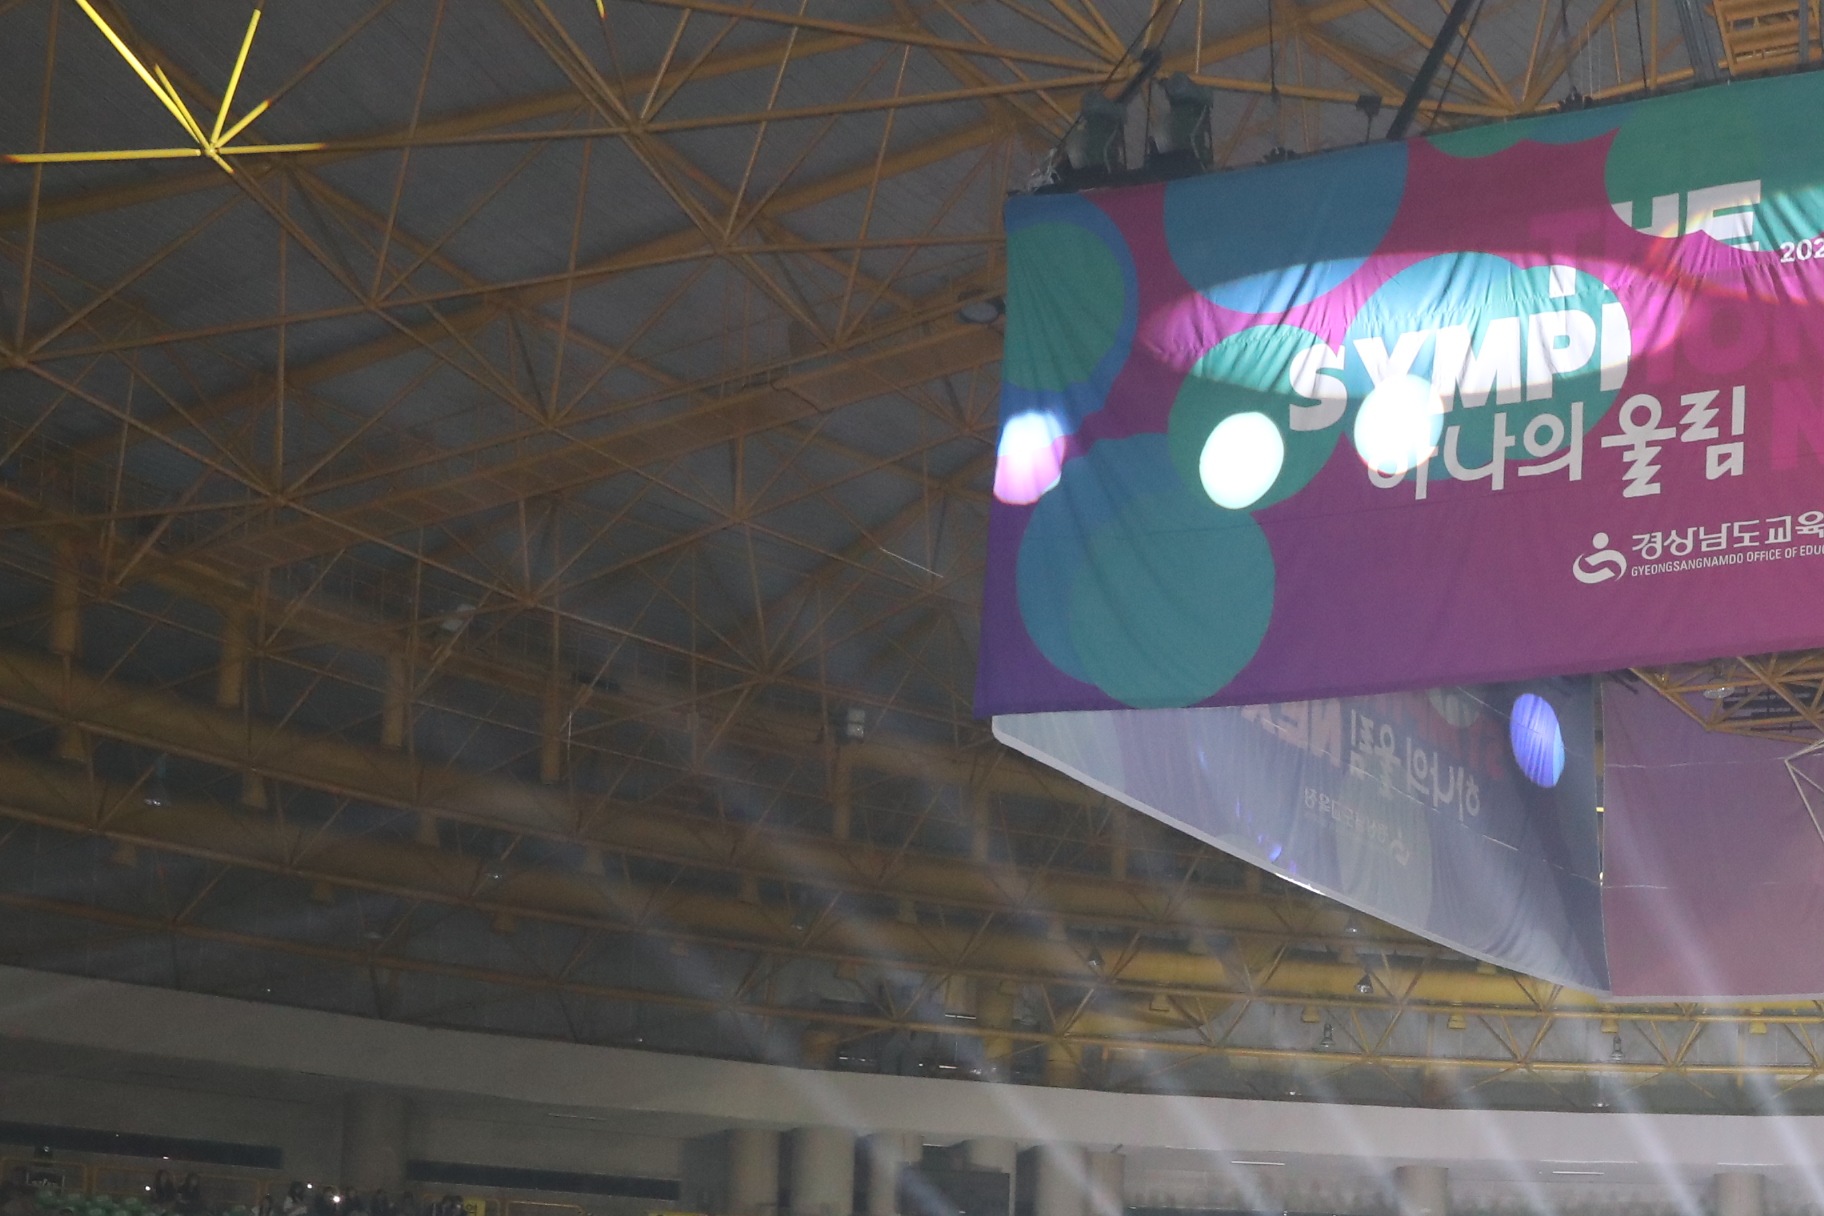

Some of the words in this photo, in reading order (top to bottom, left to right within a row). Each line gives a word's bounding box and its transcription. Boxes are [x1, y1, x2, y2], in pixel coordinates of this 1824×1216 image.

[1601, 385, 1747, 499] 울림
[1631, 551, 1744, 577] GYEONGSANGNAMDO
[1746, 548, 1782, 563] OFFICE
[1784, 546, 1798, 559] OF
